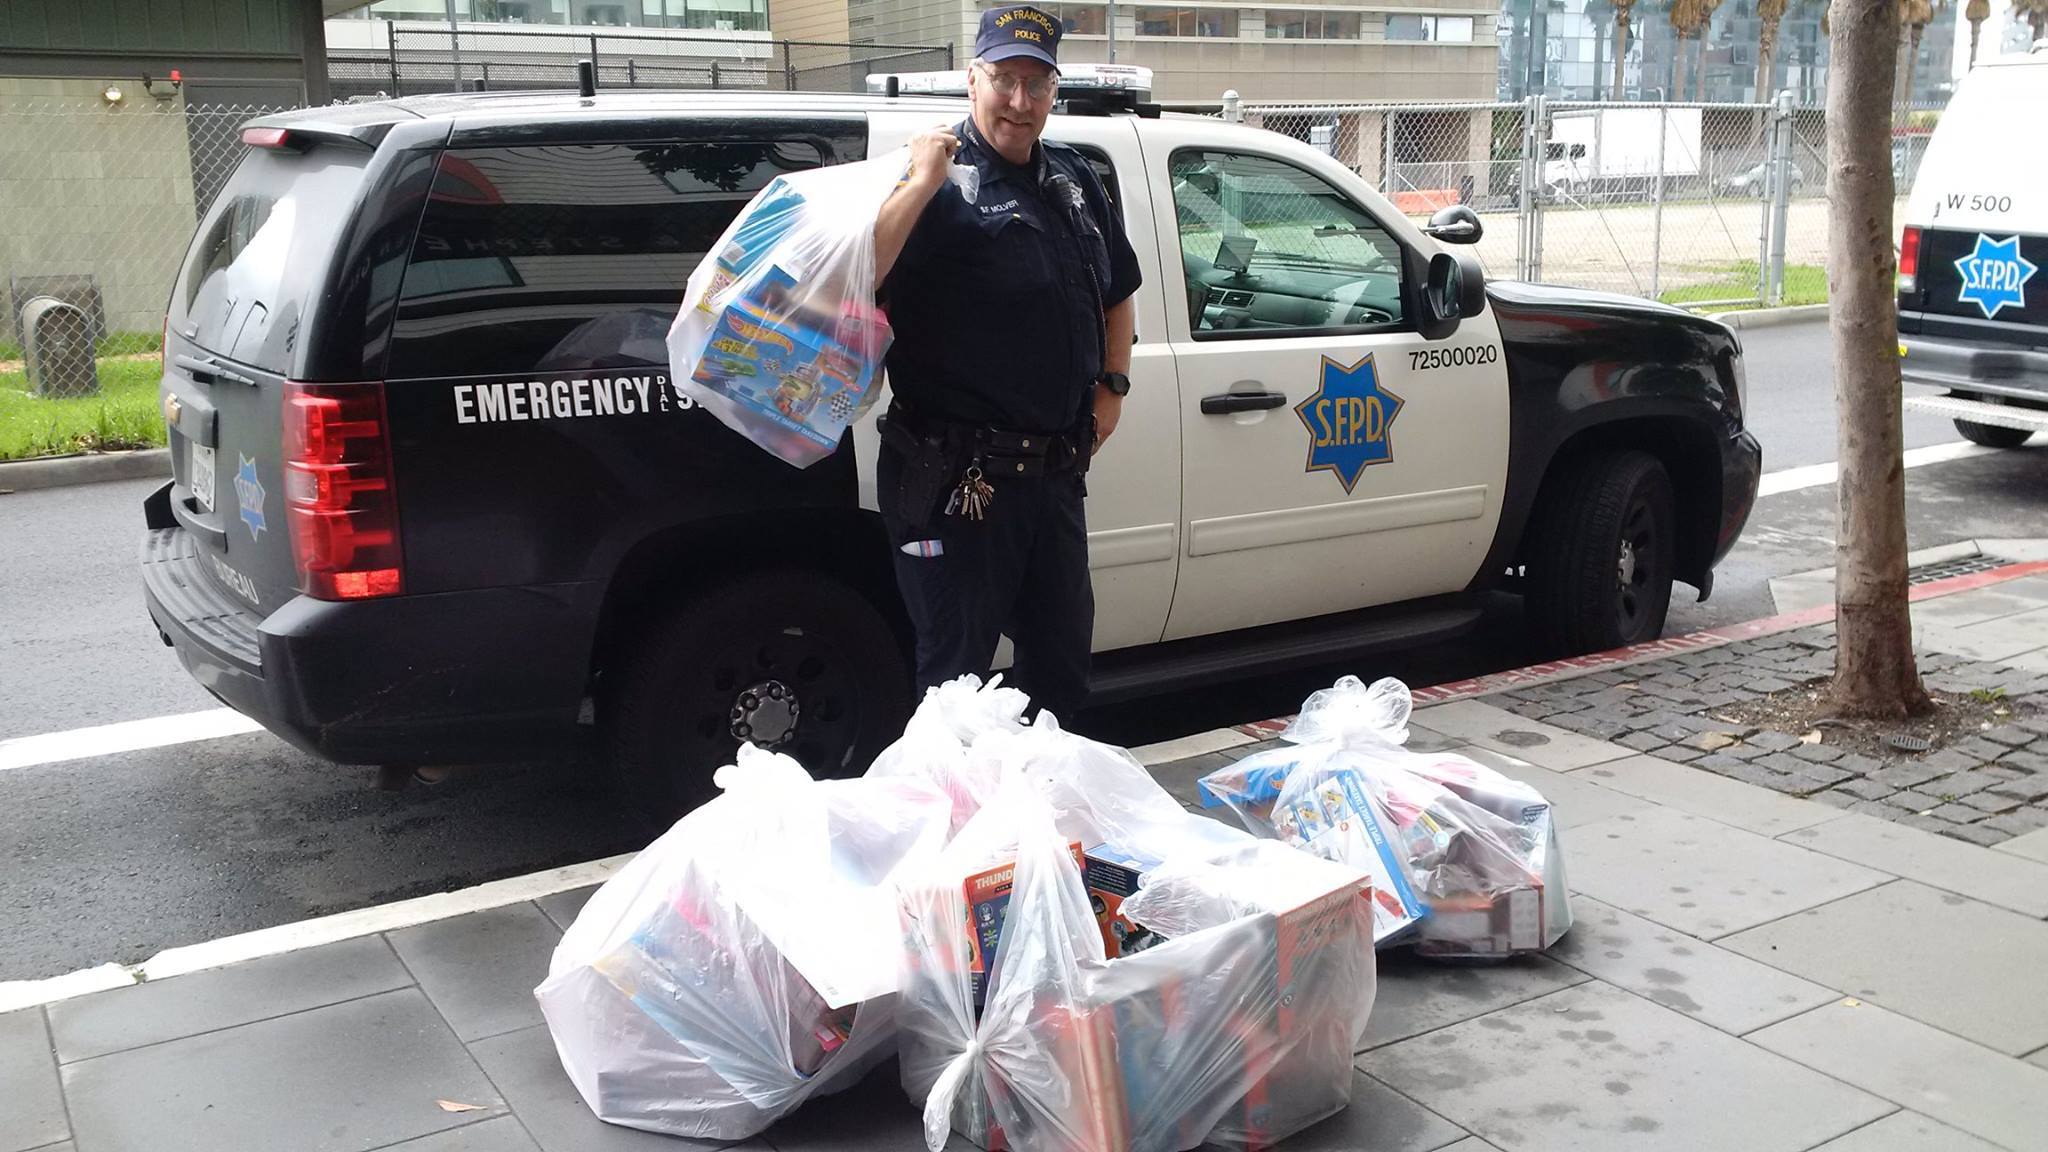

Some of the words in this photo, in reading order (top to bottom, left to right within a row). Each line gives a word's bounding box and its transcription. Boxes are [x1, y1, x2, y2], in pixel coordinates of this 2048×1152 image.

[995, 13, 1013, 28] SAN
[1013, 9, 1055, 36] FRANCISCO
[1015, 28, 1041, 42] POLICE
[1946, 193, 1965, 209] W
[1970, 194, 2012, 213] 500
[1408, 344, 1497, 371] 72500020
[453, 376, 651, 425] EMERGENCY
[657, 375, 669, 412] DIAL
